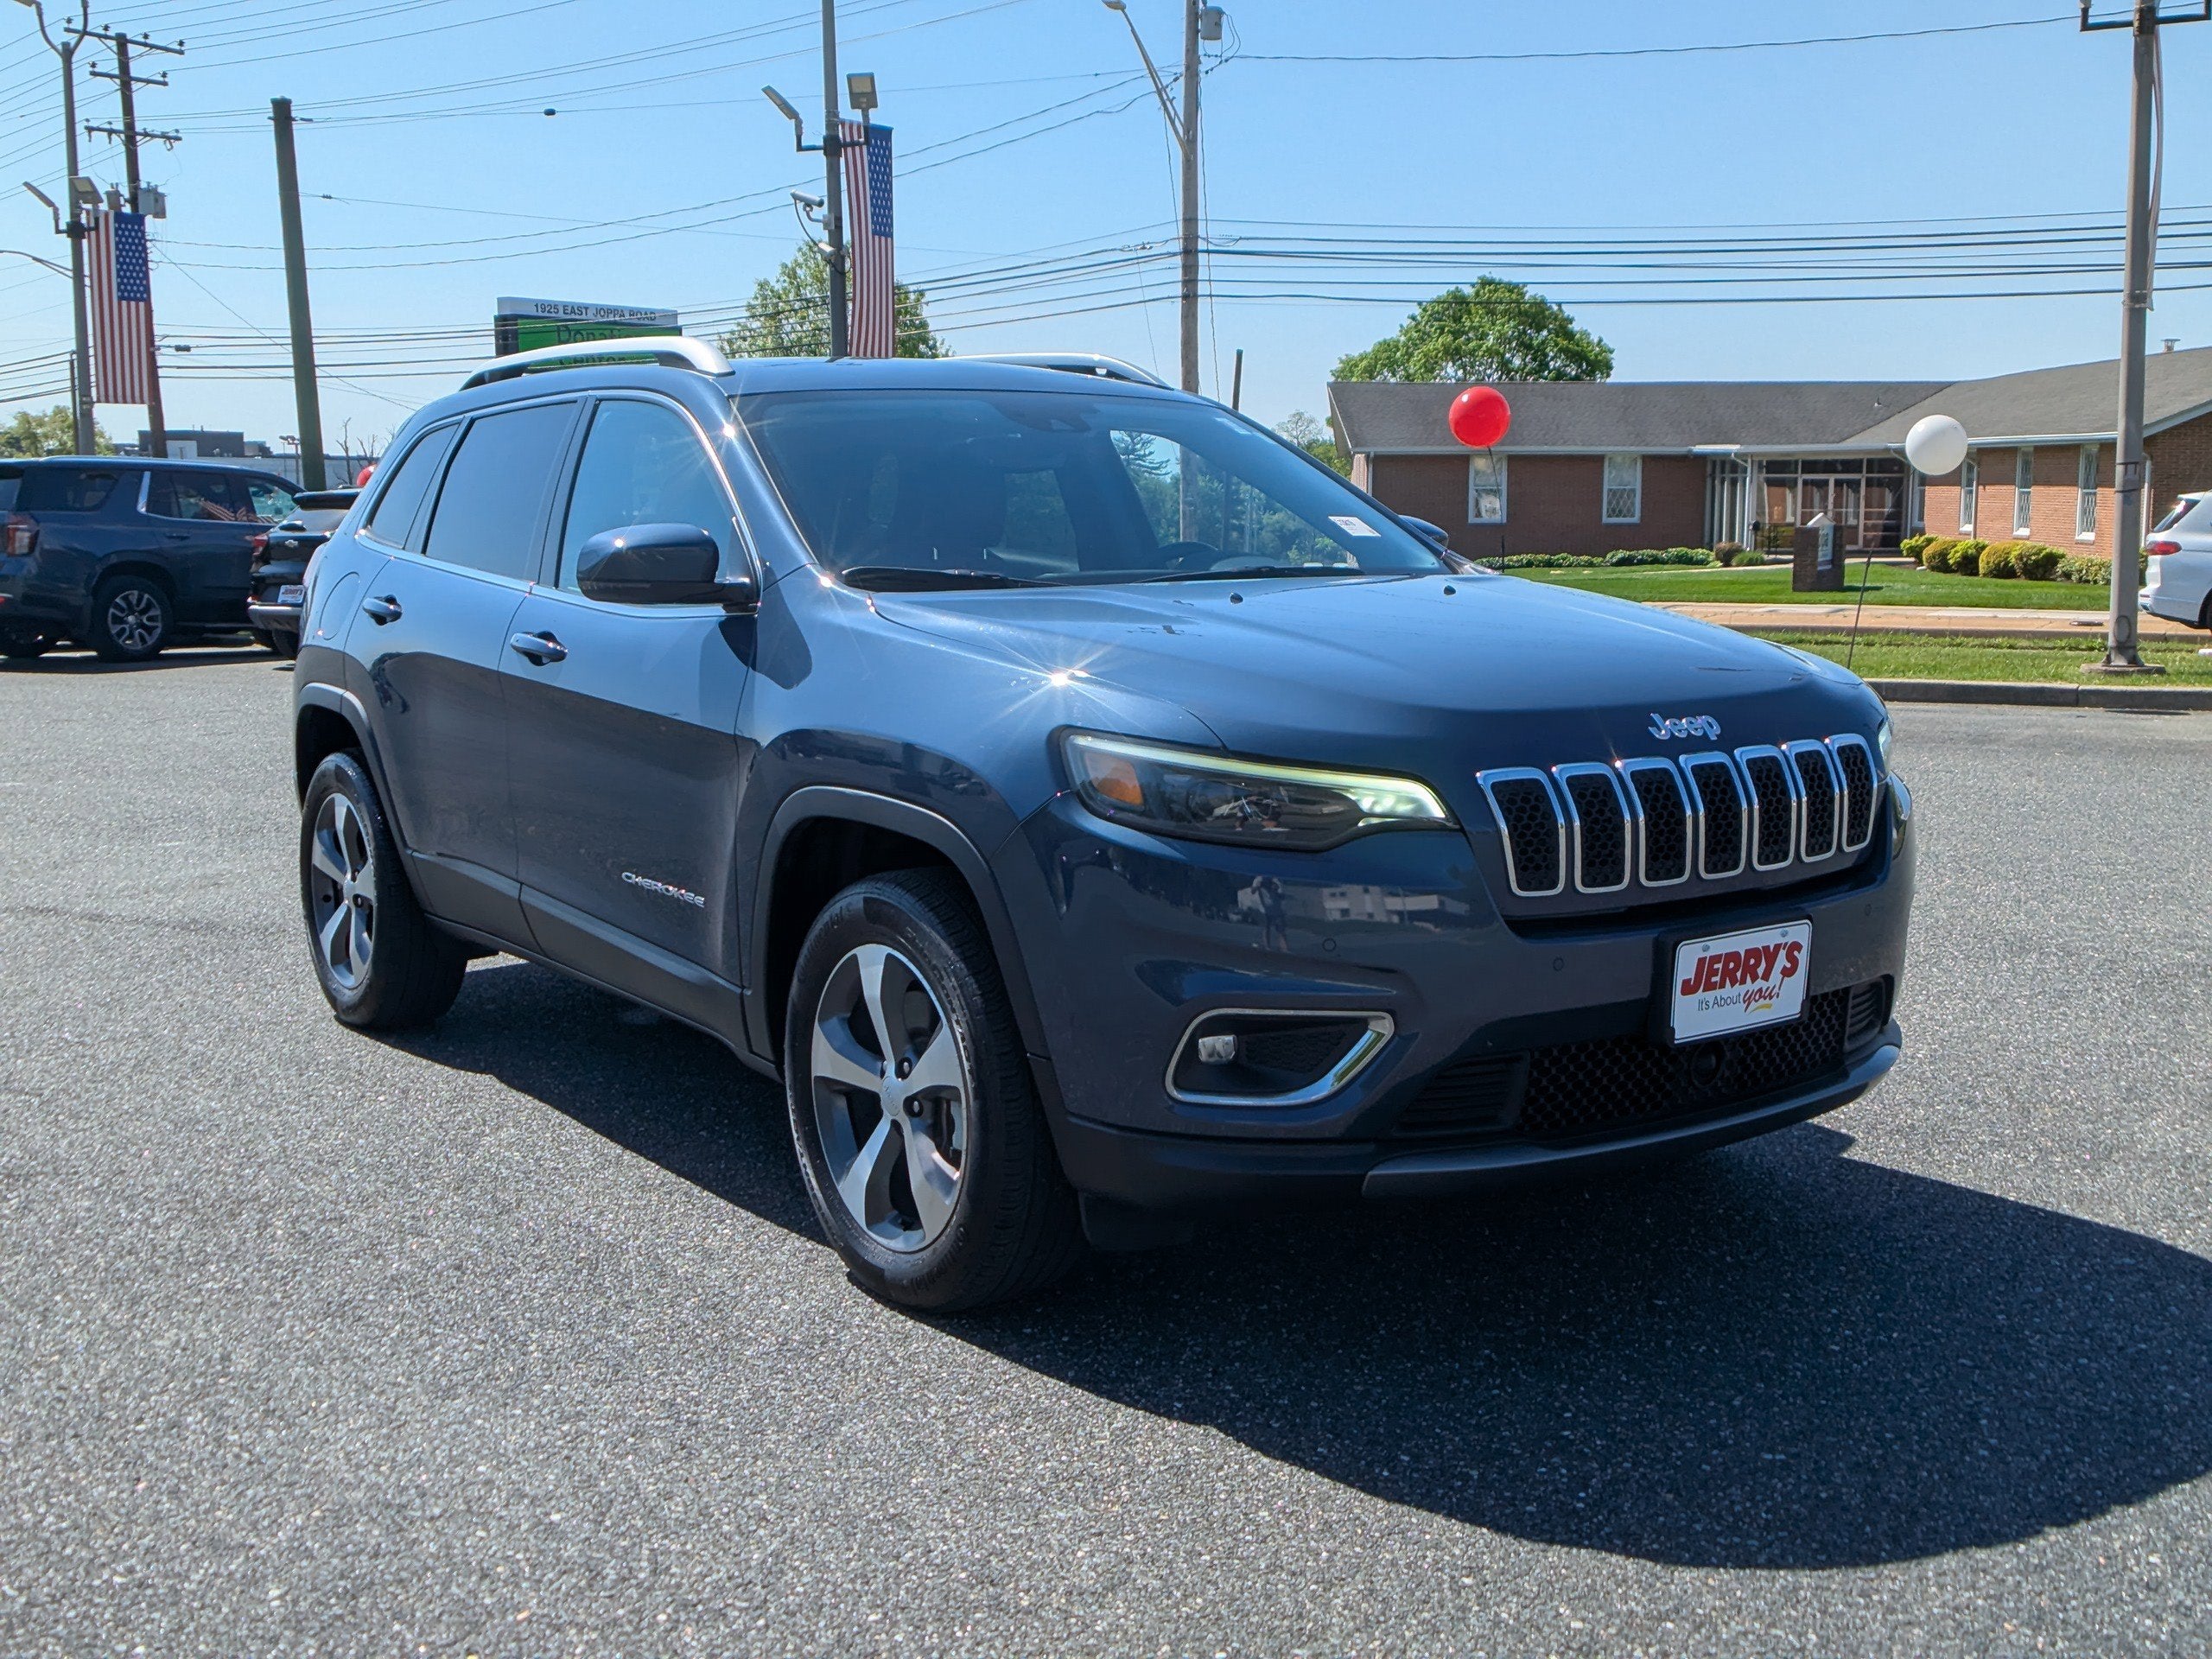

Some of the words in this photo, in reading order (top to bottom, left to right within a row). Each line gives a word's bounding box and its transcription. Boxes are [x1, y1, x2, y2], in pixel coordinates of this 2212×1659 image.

[534, 302, 559, 315] 1925
[563, 304, 589, 316] EAST
[593, 307, 626, 319] JOPPA
[628, 309, 657, 321] ROAD
[1648, 713, 1721, 741] Jeep
[621, 872, 705, 908] CHEROKEE
[1680, 940, 1804, 996] JERRY'S
[1697, 997, 1710, 1012] It's
[1712, 993, 1742, 1009] About
[1742, 976, 1786, 1014] you!
